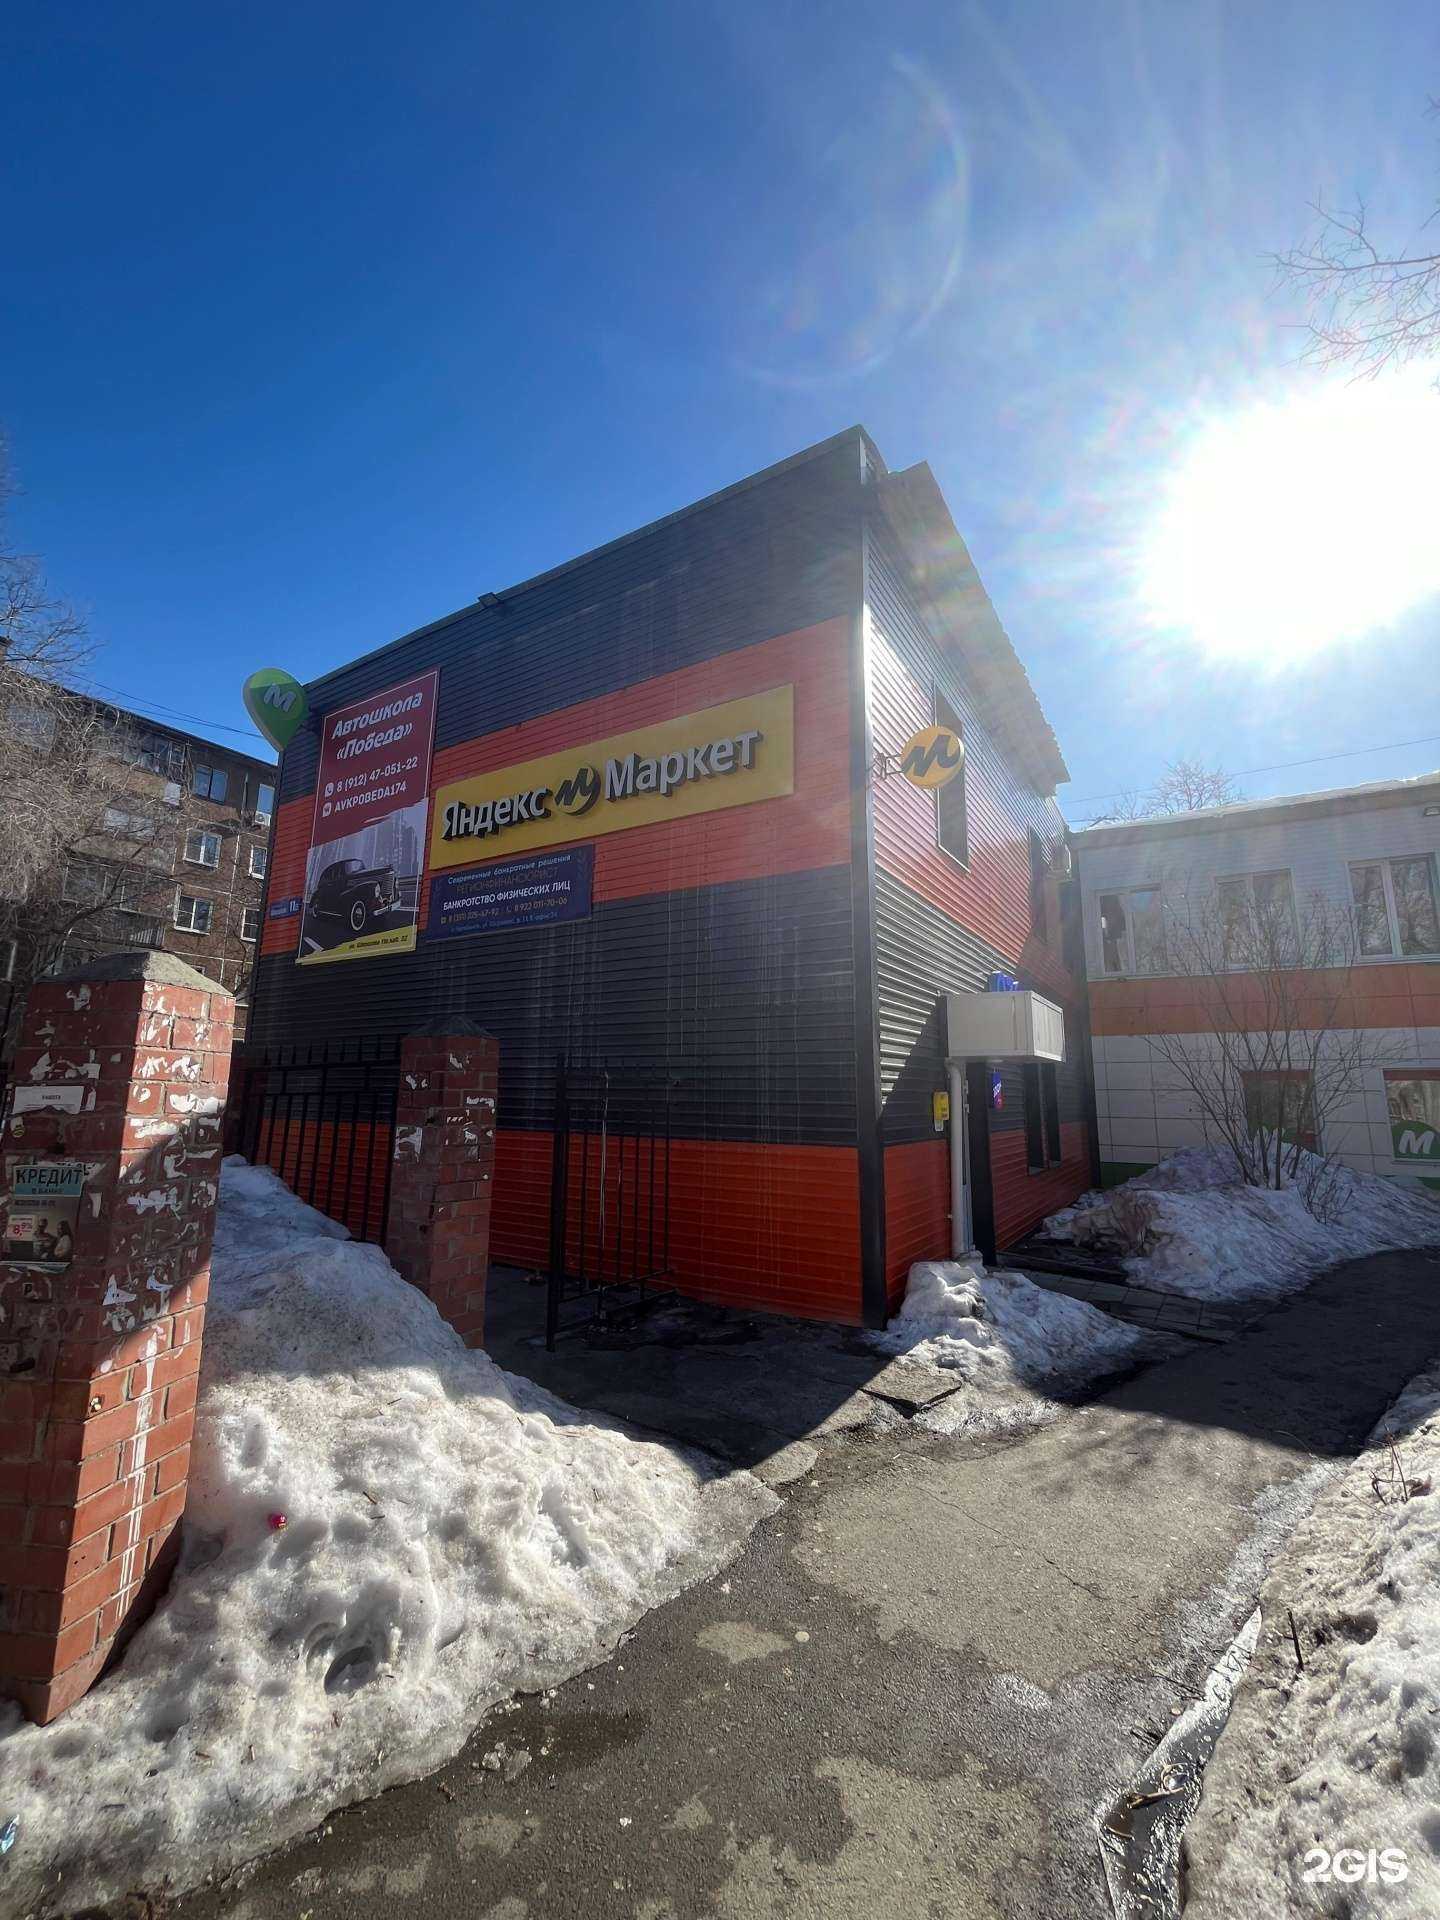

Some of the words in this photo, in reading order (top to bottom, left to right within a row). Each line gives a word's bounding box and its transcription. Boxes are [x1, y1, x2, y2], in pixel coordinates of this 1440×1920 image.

[332, 692, 423, 739] Автошкола
[337, 722, 413, 760] «Победа»
[337, 781, 343, 793] 8
[345, 772, 367, 792] (912)
[369, 756, 418, 781] 47-051-22
[440, 785, 553, 842] Яндекс
[604, 729, 763, 802] Маркет
[443, 893, 496, 911] БАНКРОТСТВО
[496, 882, 550, 902] ФИЗИЧЕСКИХ
[552, 880, 571, 893] ЛИЦ
[16, 1167, 83, 1187] КРЕДИТ
